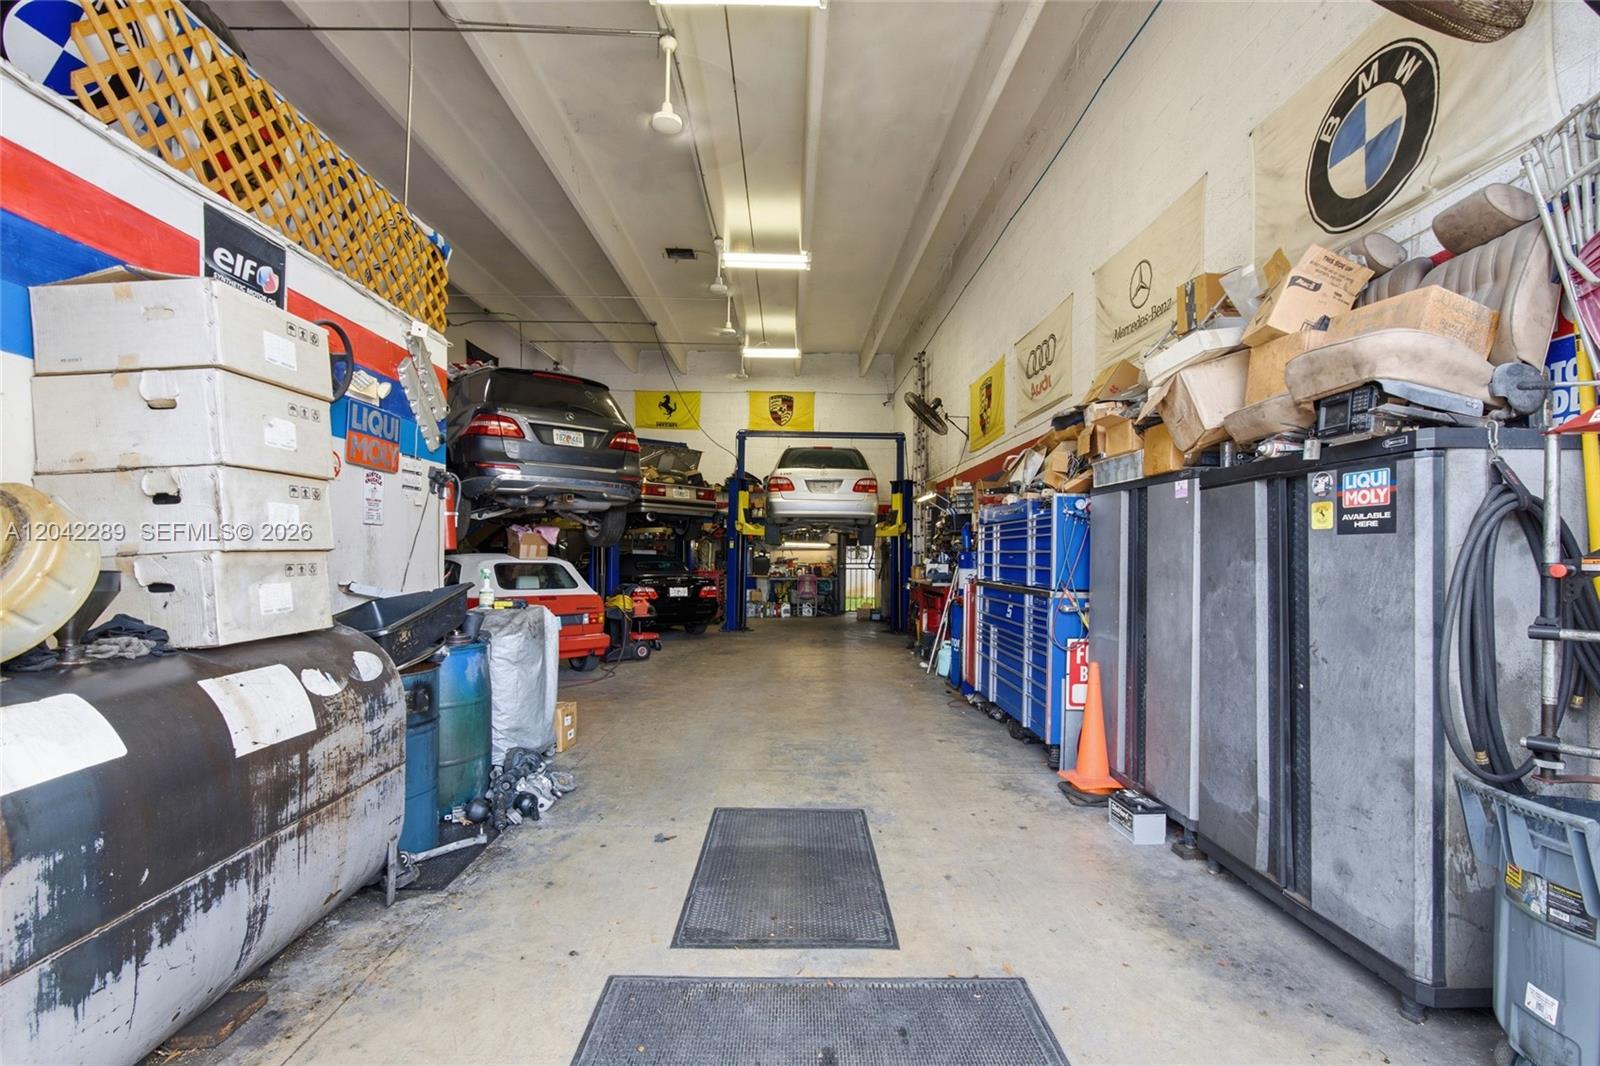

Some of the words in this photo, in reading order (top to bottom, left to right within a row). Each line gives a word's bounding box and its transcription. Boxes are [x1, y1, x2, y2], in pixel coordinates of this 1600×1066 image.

[1320, 50, 1423, 143] BMW
[213, 247, 257, 281] elf
[1112, 297, 1172, 343] Mercedes-Benz
[1030, 373, 1053, 398] Audi
[351, 403, 400, 442] LIQUI
[350, 436, 400, 468] MOLY
[1345, 470, 1388, 490] LIQUI
[1345, 487, 1389, 506] MOLY
[1342, 511, 1391, 521] AVAILABLE
[1354, 520, 1379, 528] HERE
